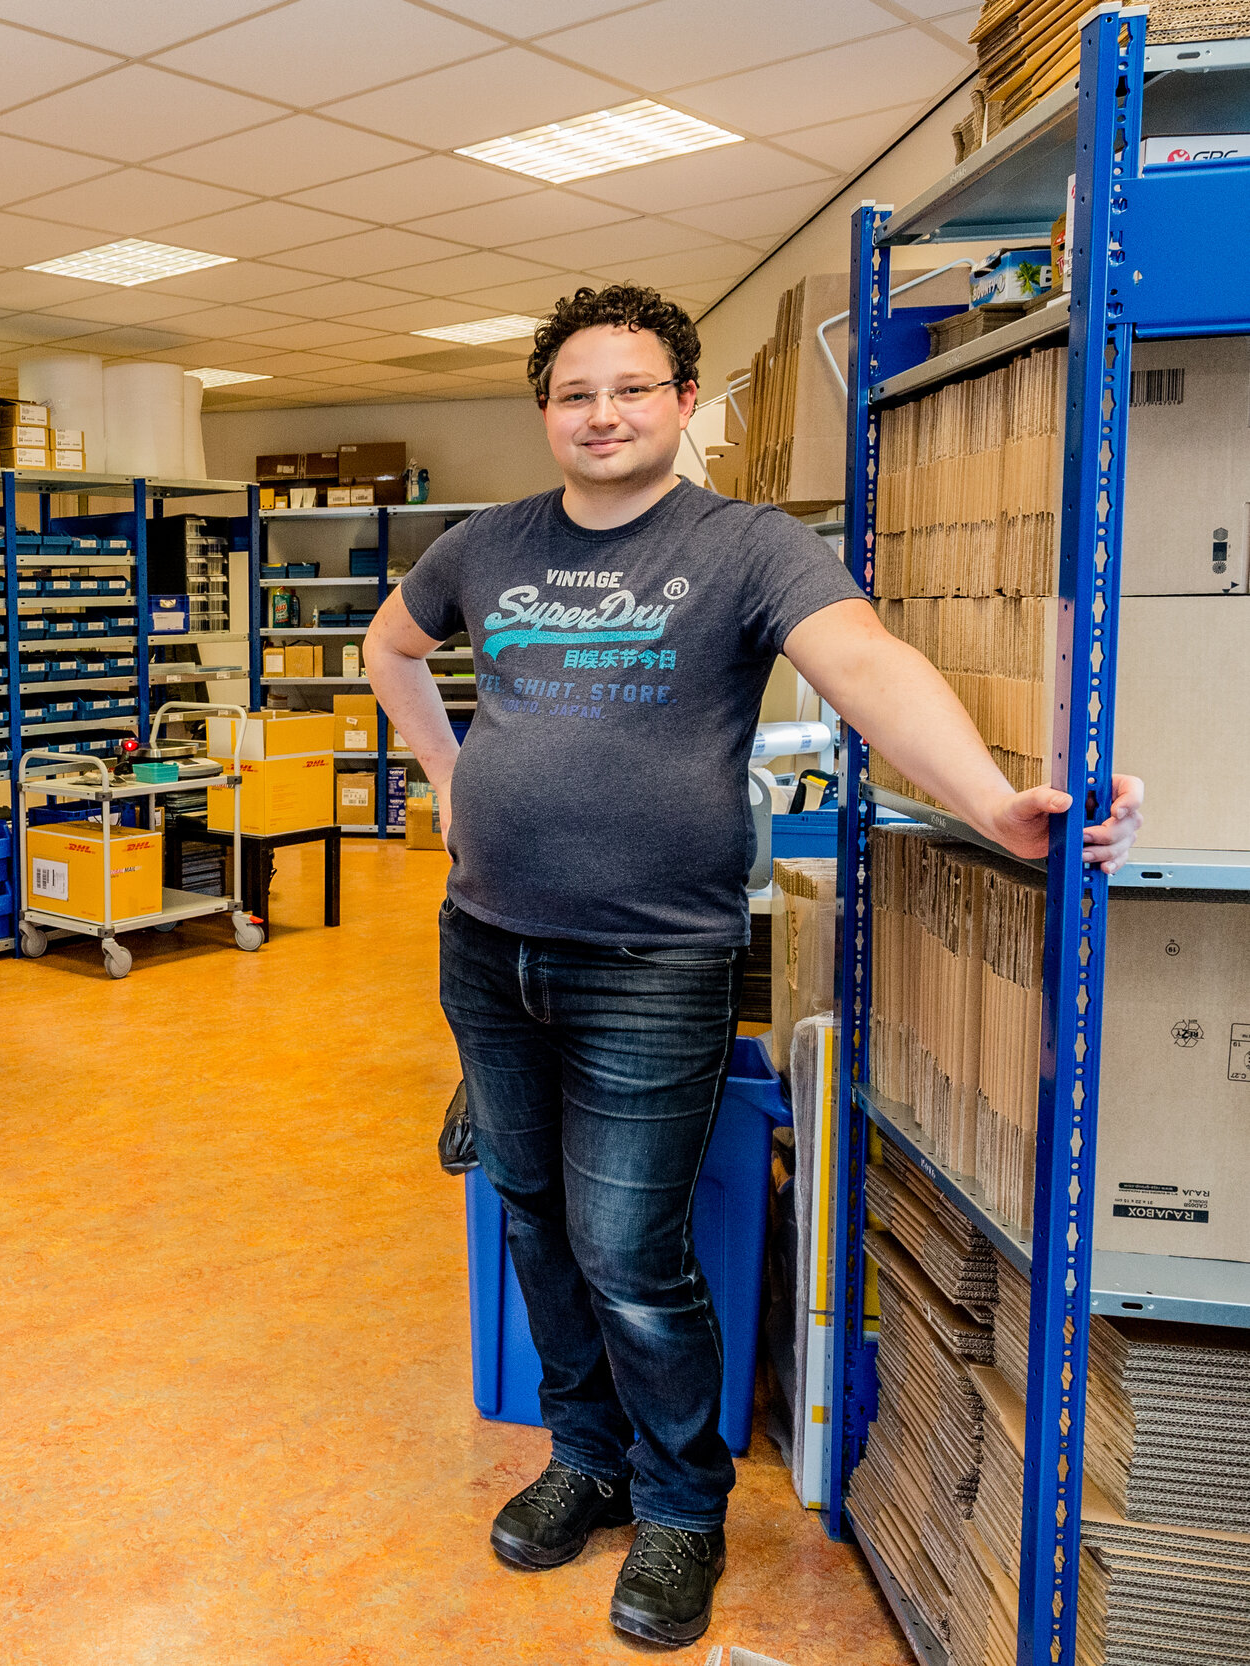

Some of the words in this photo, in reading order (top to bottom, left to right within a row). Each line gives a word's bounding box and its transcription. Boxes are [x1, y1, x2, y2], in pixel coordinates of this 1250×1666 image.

[546, 569, 624, 589] VINTAGE
[68, 843, 91, 854] DHL
[126, 841, 151, 852] DHL
[1182, 1189, 1210, 1198] RAJA
[1128, 1207, 1194, 1220] RAJABOX
